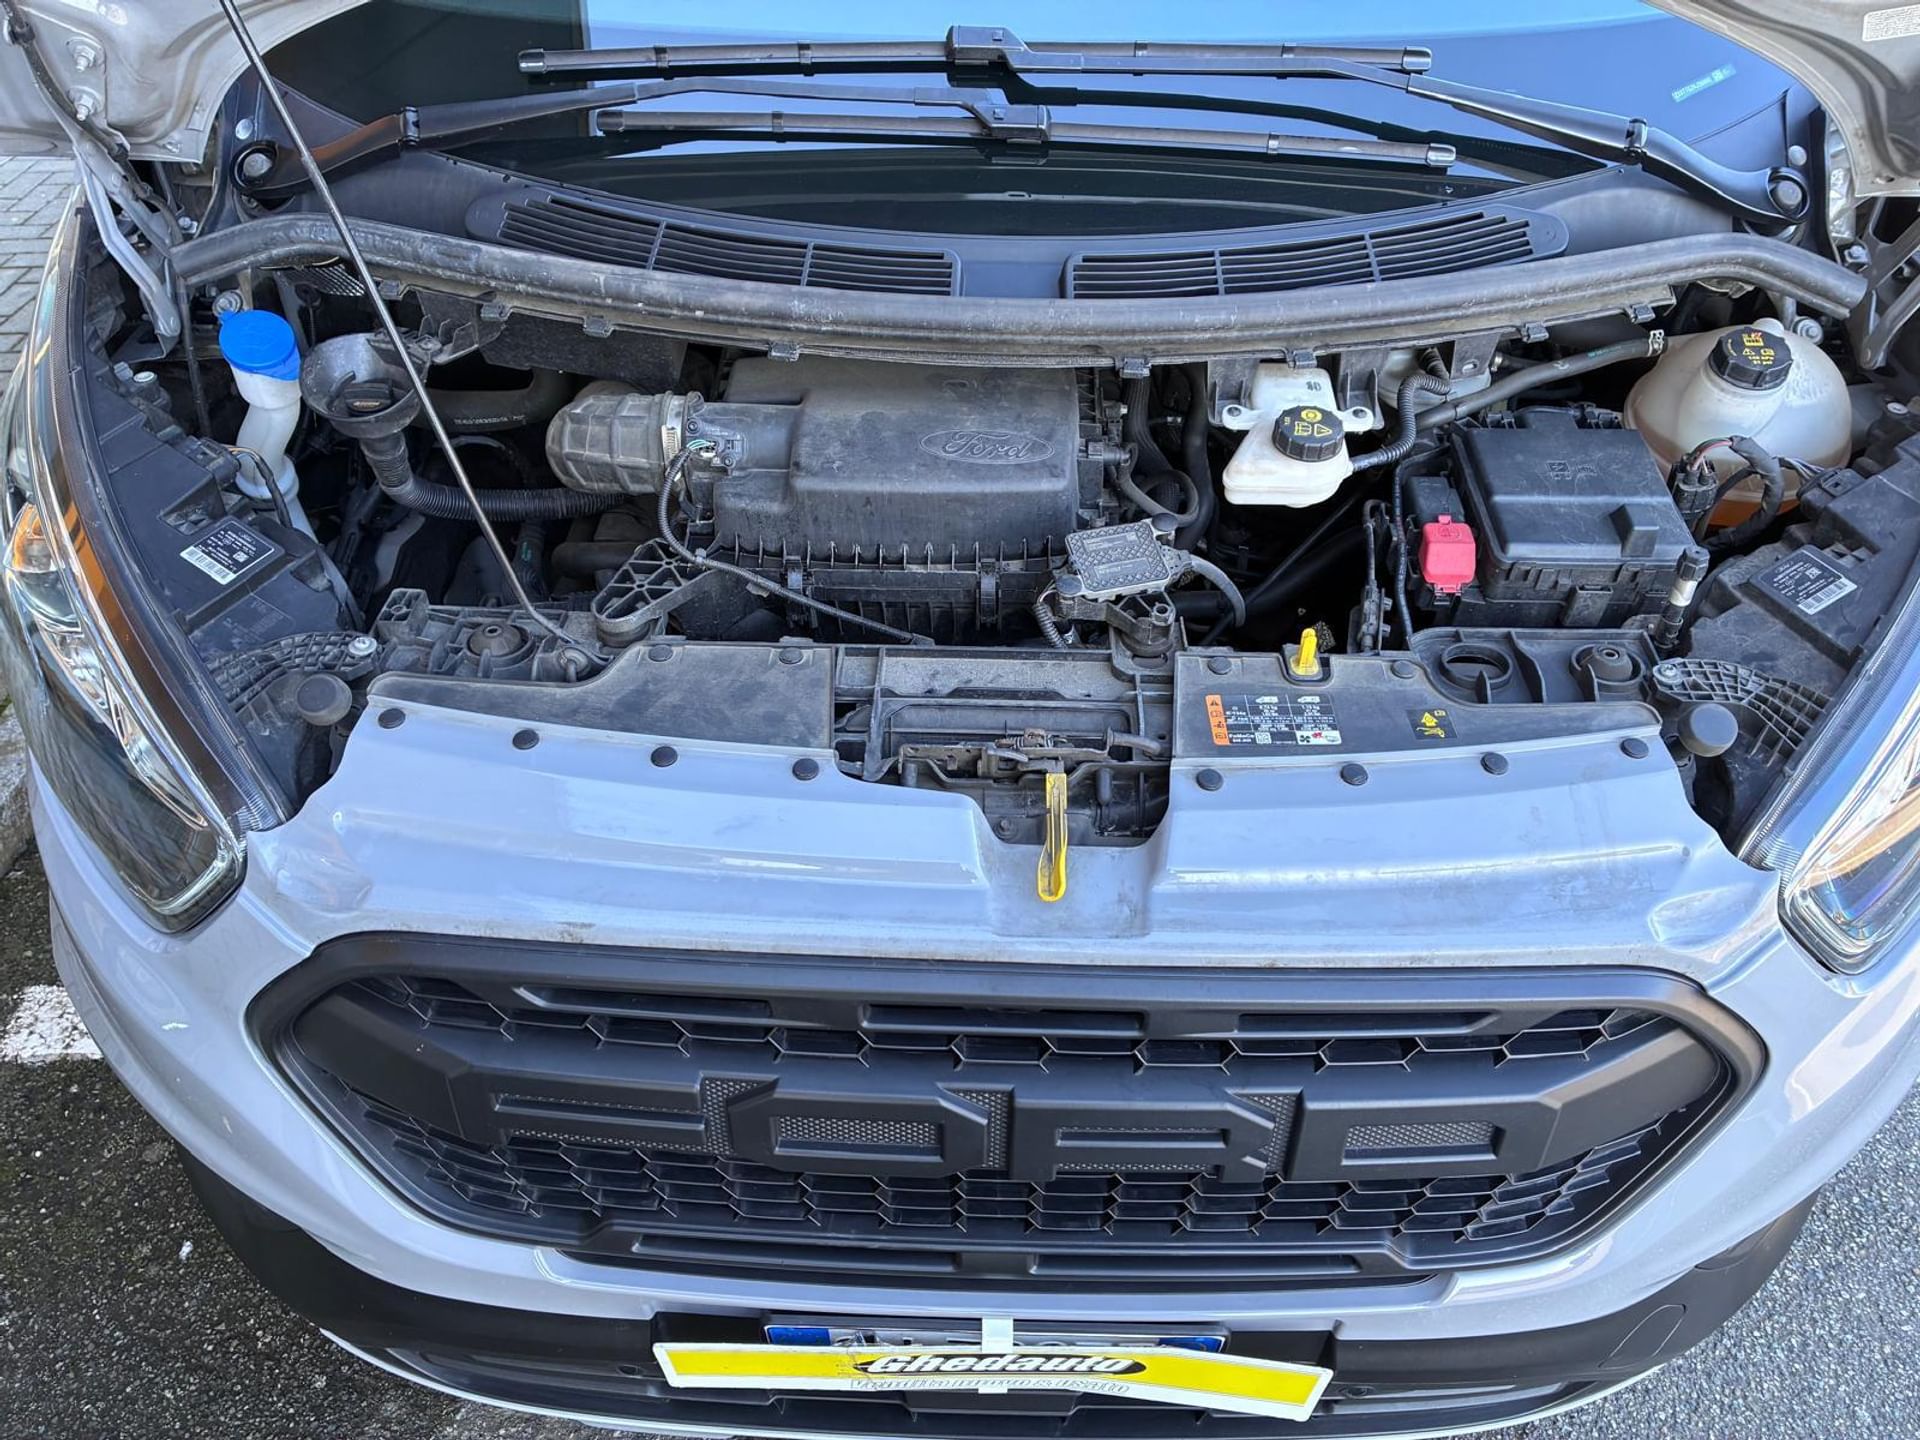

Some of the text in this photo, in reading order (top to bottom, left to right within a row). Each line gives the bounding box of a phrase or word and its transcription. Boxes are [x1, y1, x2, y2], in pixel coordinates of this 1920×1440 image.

[942, 430, 1032, 459] Ford
[458, 1078, 1558, 1182] FORD
[867, 1353, 1135, 1373] Ghedauto
